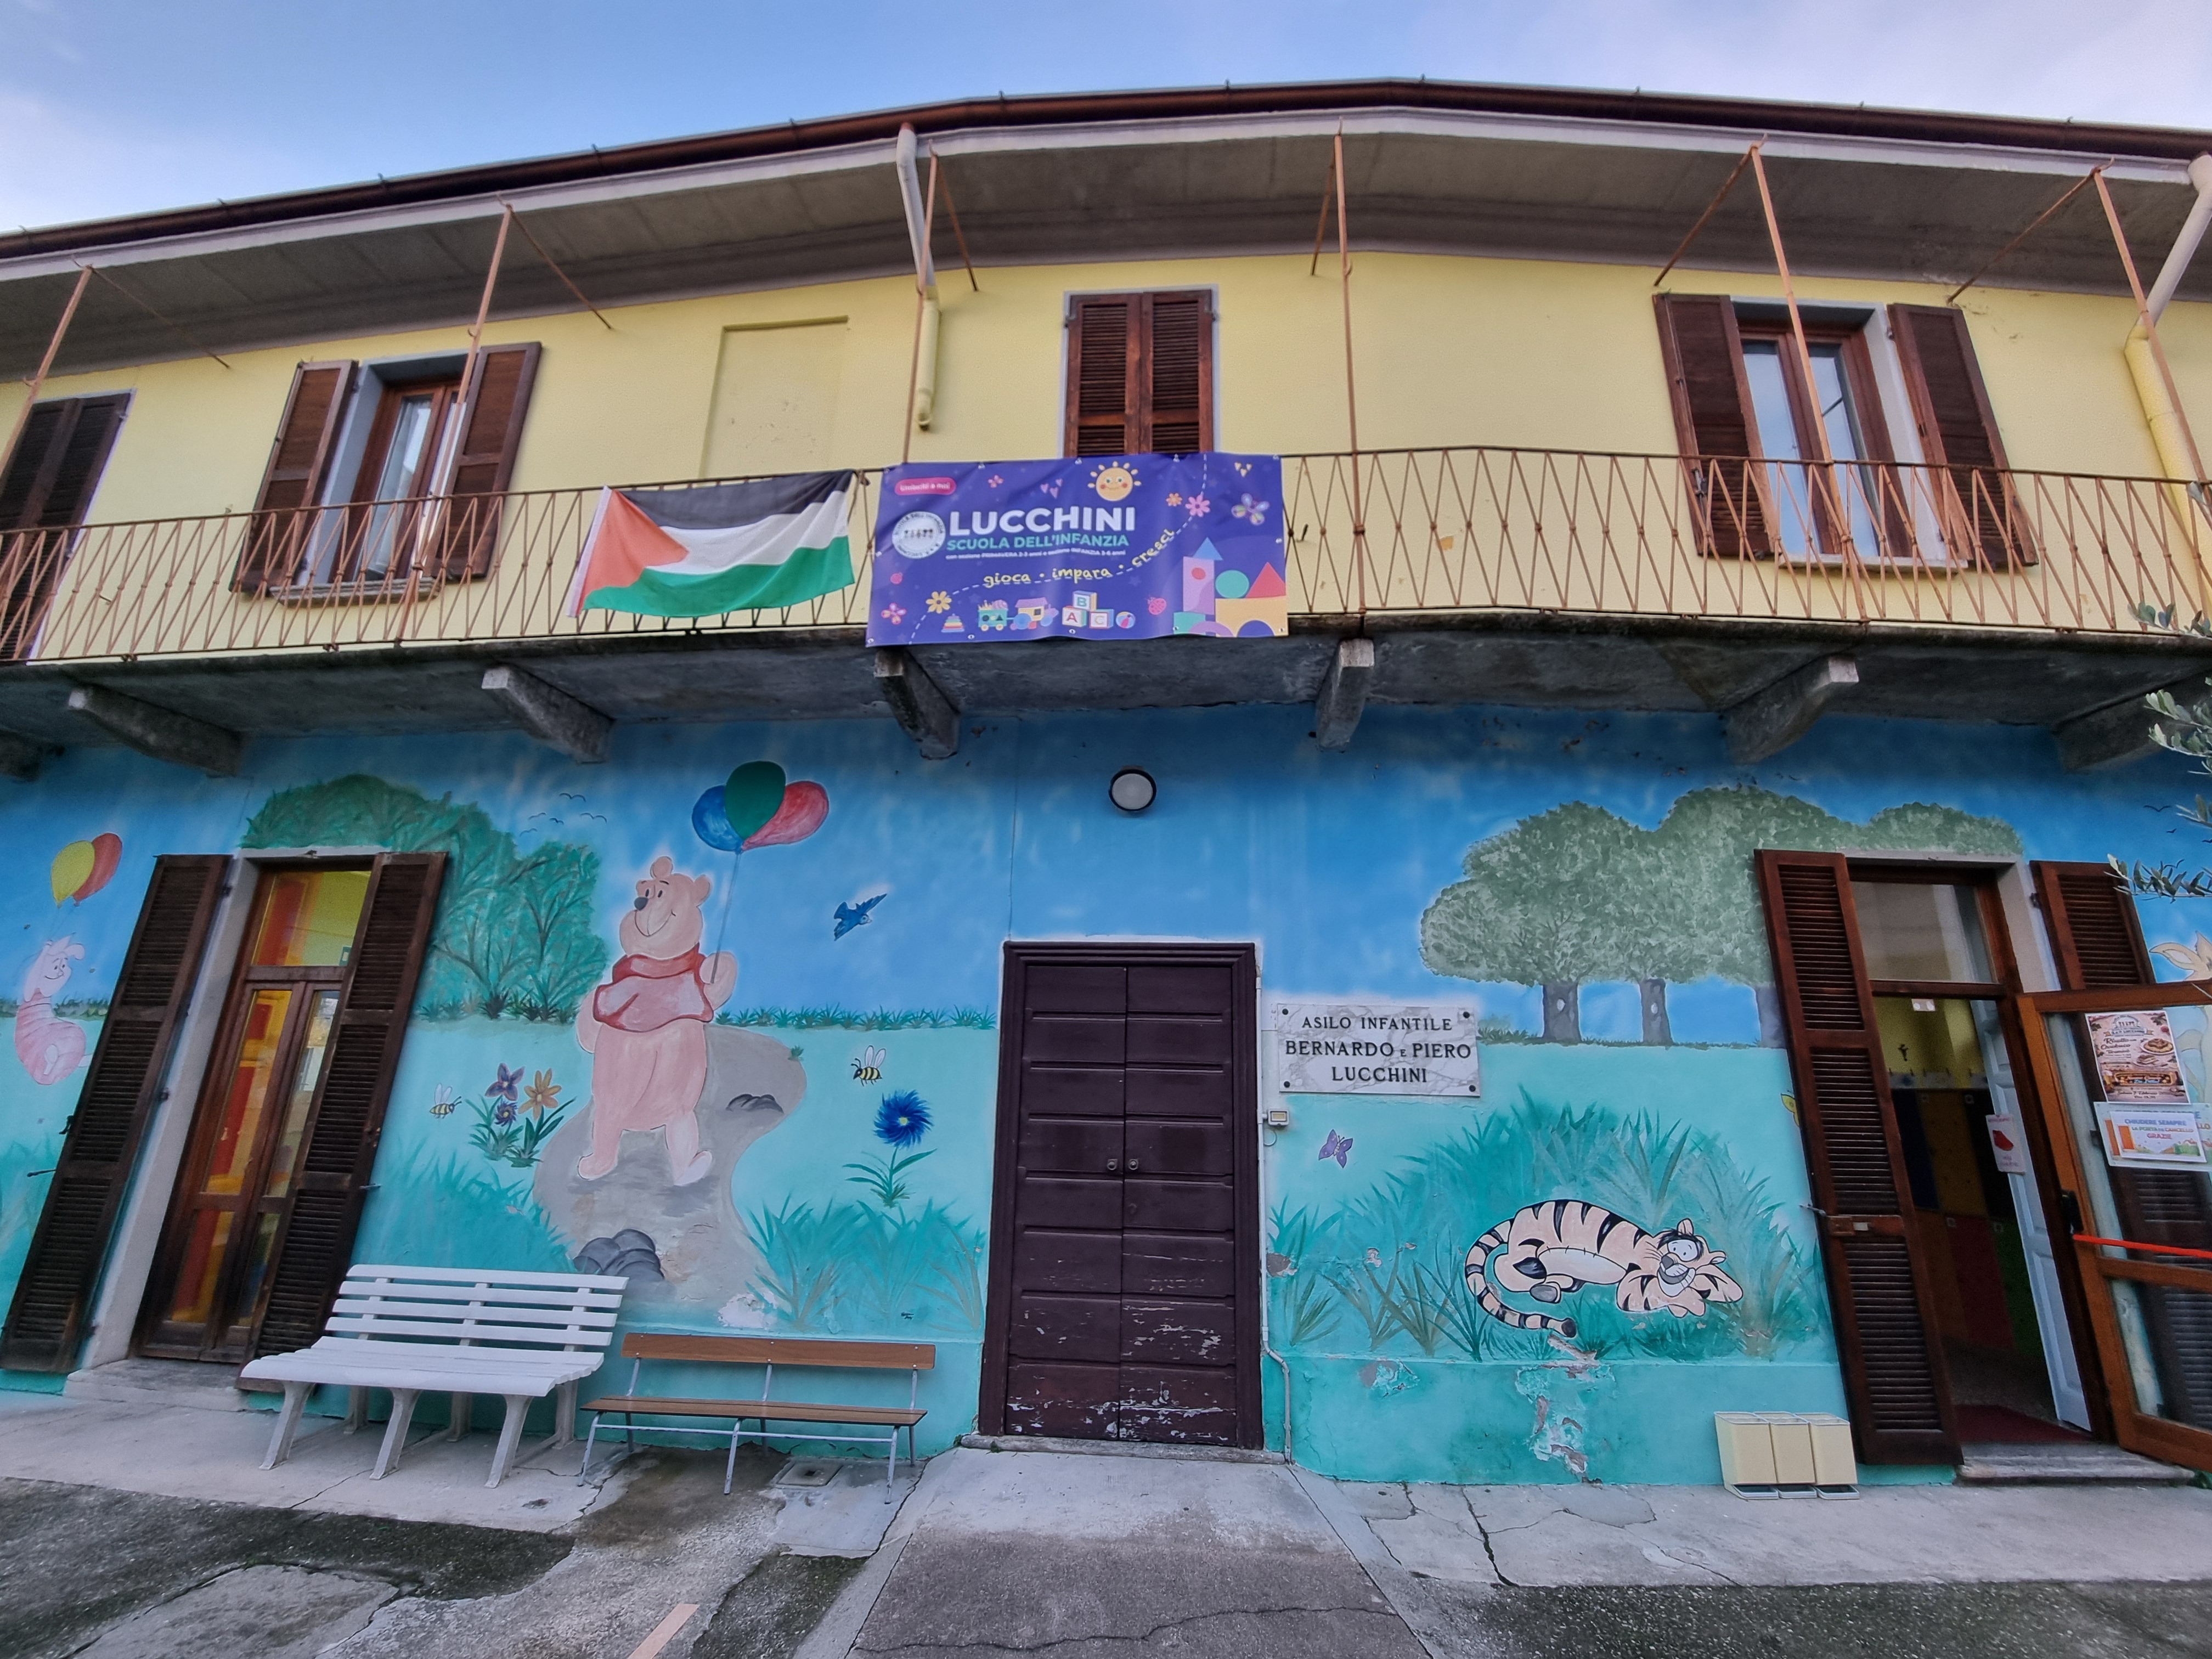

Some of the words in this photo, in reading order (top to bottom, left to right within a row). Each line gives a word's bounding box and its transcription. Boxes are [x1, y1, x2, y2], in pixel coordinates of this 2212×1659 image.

[950, 506, 1135, 536] LUCCHINI
[947, 537, 1009, 550] SCUOLA
[1014, 533, 1129, 548] DELL'INFANZIA
[984, 573, 1031, 588] gioca
[1052, 568, 1112, 584] impara
[1132, 528, 1175, 566] cresci
[1077, 597, 1087, 606] B
[1066, 612, 1077, 623] A
[1094, 616, 1104, 624] C
[1302, 1017, 1351, 1029] ASILO
[1361, 1017, 1452, 1030] INFANTILE
[1285, 1041, 1394, 1057] BERNARDO
[1400, 1048, 1407, 1057] E
[1413, 1043, 1471, 1058] PIERO
[1331, 1066, 1427, 1082] LUCCHINI
